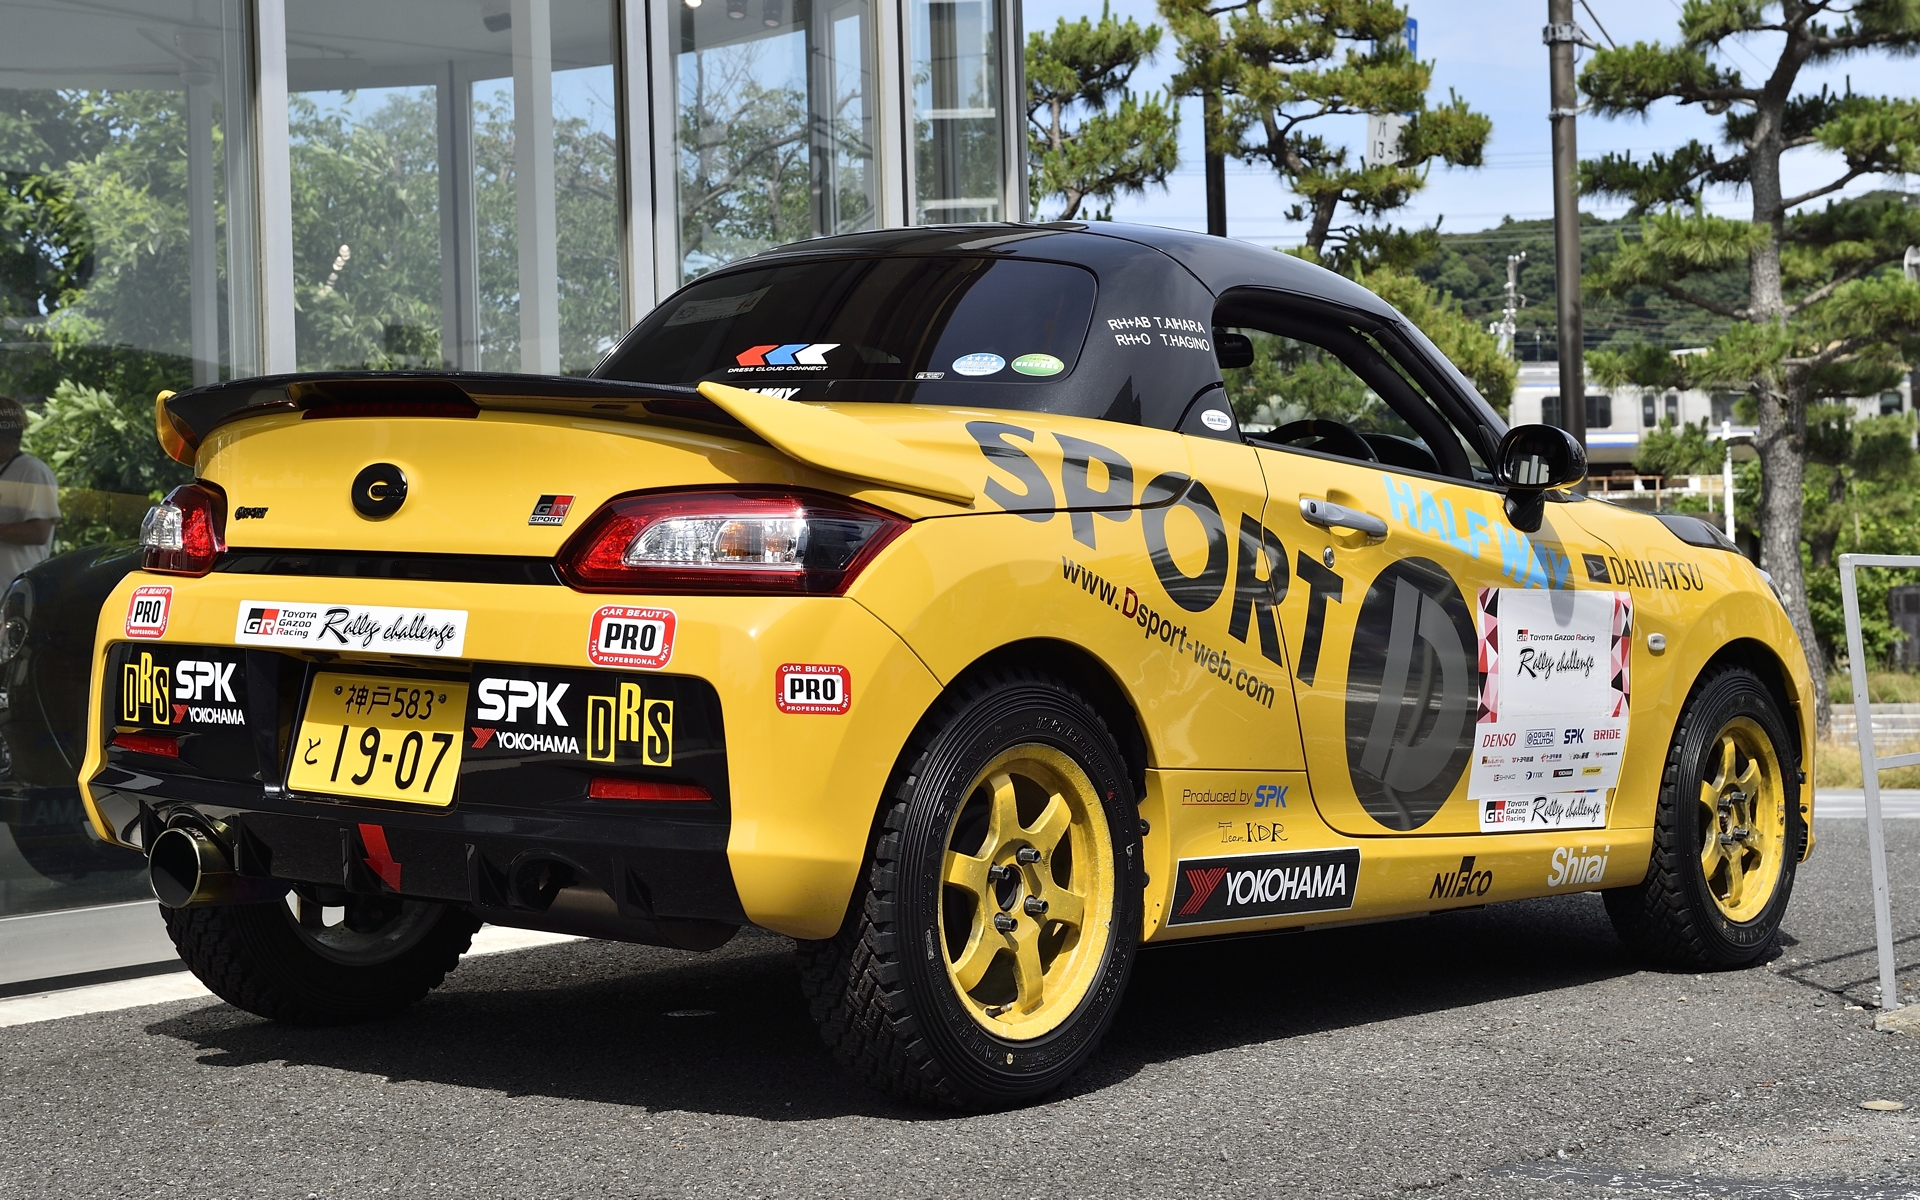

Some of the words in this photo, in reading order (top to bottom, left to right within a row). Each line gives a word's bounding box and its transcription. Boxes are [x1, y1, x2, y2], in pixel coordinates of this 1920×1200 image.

[1107, 316, 1151, 331] RH+AB
[1153, 316, 1206, 334] T.AIHARA
[1114, 333, 1151, 346] RH+O
[1159, 333, 1210, 352] T.HAGINO
[534, 503, 570, 515] GR
[1381, 474, 1491, 560] HALF
[1495, 520, 1571, 591] WAY
[964, 420, 1344, 688] SPORT
[1608, 556, 1705, 591] DAIHATSU
[134, 599, 161, 624] PRO
[279, 618, 312, 628] GAZOO
[282, 609, 317, 619] TOYOTA
[601, 608, 623, 616] CAR
[626, 609, 670, 619] BEAUTY
[244, 618, 274, 635] GR
[276, 627, 309, 639] Racing
[316, 606, 381, 649] Rally
[382, 613, 457, 651] challenge
[604, 622, 657, 652] PRO
[1061, 555, 1275, 709] www.Dsport-web.com
[1517, 632, 1528, 641] GR
[1530, 633, 1552, 641] TOYOTA
[1554, 633, 1576, 641] GAZOO
[1576, 633, 1596, 643] Racing
[598, 655, 657, 666] PROFESSIONAL
[659, 643, 669, 662] WAY
[1517, 647, 1555, 681] Rally
[1556, 648, 1595, 679] challenge
[175, 659, 237, 703] SPK
[805, 665, 844, 674] BEAUTY
[124, 652, 170, 725] DRS
[789, 677, 836, 701] PRO
[477, 677, 571, 727] SPK
[188, 706, 246, 725] YOKOHAMA
[586, 682, 674, 767] DRS
[496, 731, 580, 755] YOKOHAMA
[1482, 732, 1517, 748] DENSO
[1532, 738, 1554, 746] CLUTCH
[1533, 731, 1554, 739] OGURA
[1563, 728, 1585, 745] SPK
[1593, 729, 1621, 741] BRIDE
[304, 737, 322, 765] と
[329, 724, 454, 793] 19-07
[1182, 788, 1236, 803] Produced
[1240, 789, 1253, 805] by
[1254, 784, 1289, 807] SPK
[1485, 809, 1504, 823] GR
[1505, 815, 1526, 823] Racing
[1530, 796, 1564, 825] Rally
[1565, 796, 1601, 823] challenge
[1547, 844, 1610, 887] Shirai
[1226, 863, 1346, 906] YOKOHAMA
[1428, 856, 1493, 899] NIFCO
